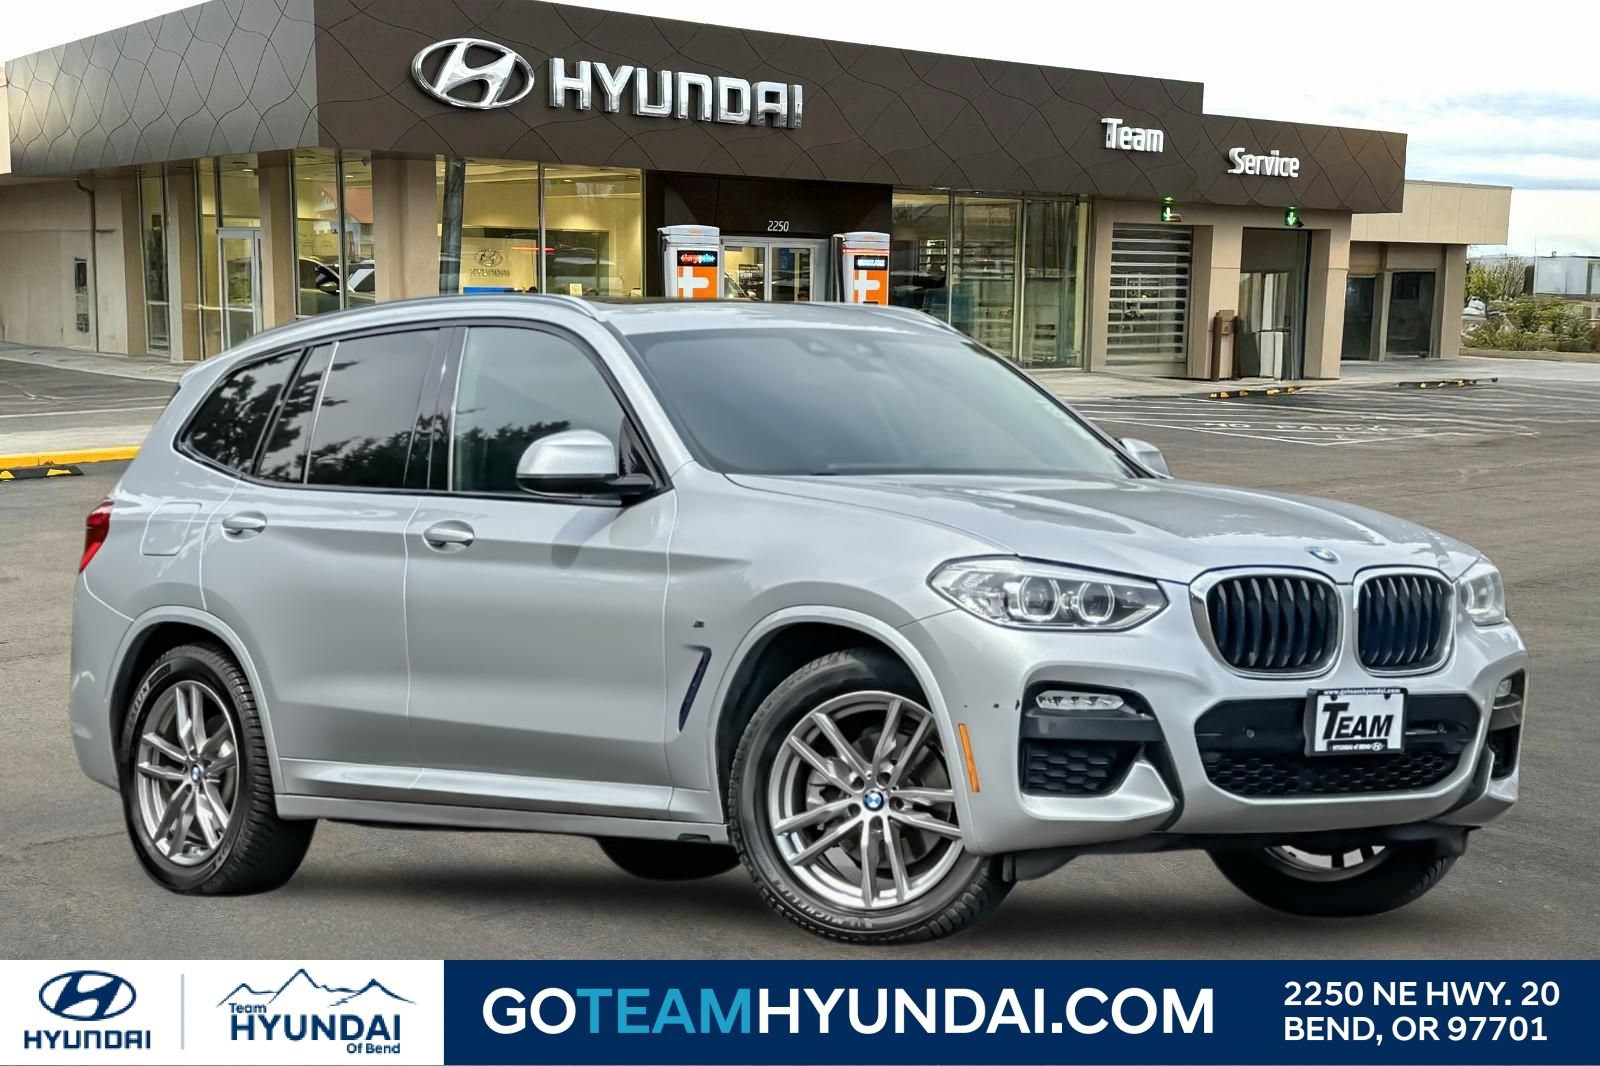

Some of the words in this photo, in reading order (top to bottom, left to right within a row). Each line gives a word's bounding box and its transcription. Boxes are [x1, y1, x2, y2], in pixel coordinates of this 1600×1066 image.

[548, 57, 803, 128] HYUNDAI
[1101, 117, 1164, 153] Team
[1227, 147, 1300, 178] Service
[767, 220, 790, 232] 2250
[1322, 702, 1394, 740] TEAM
